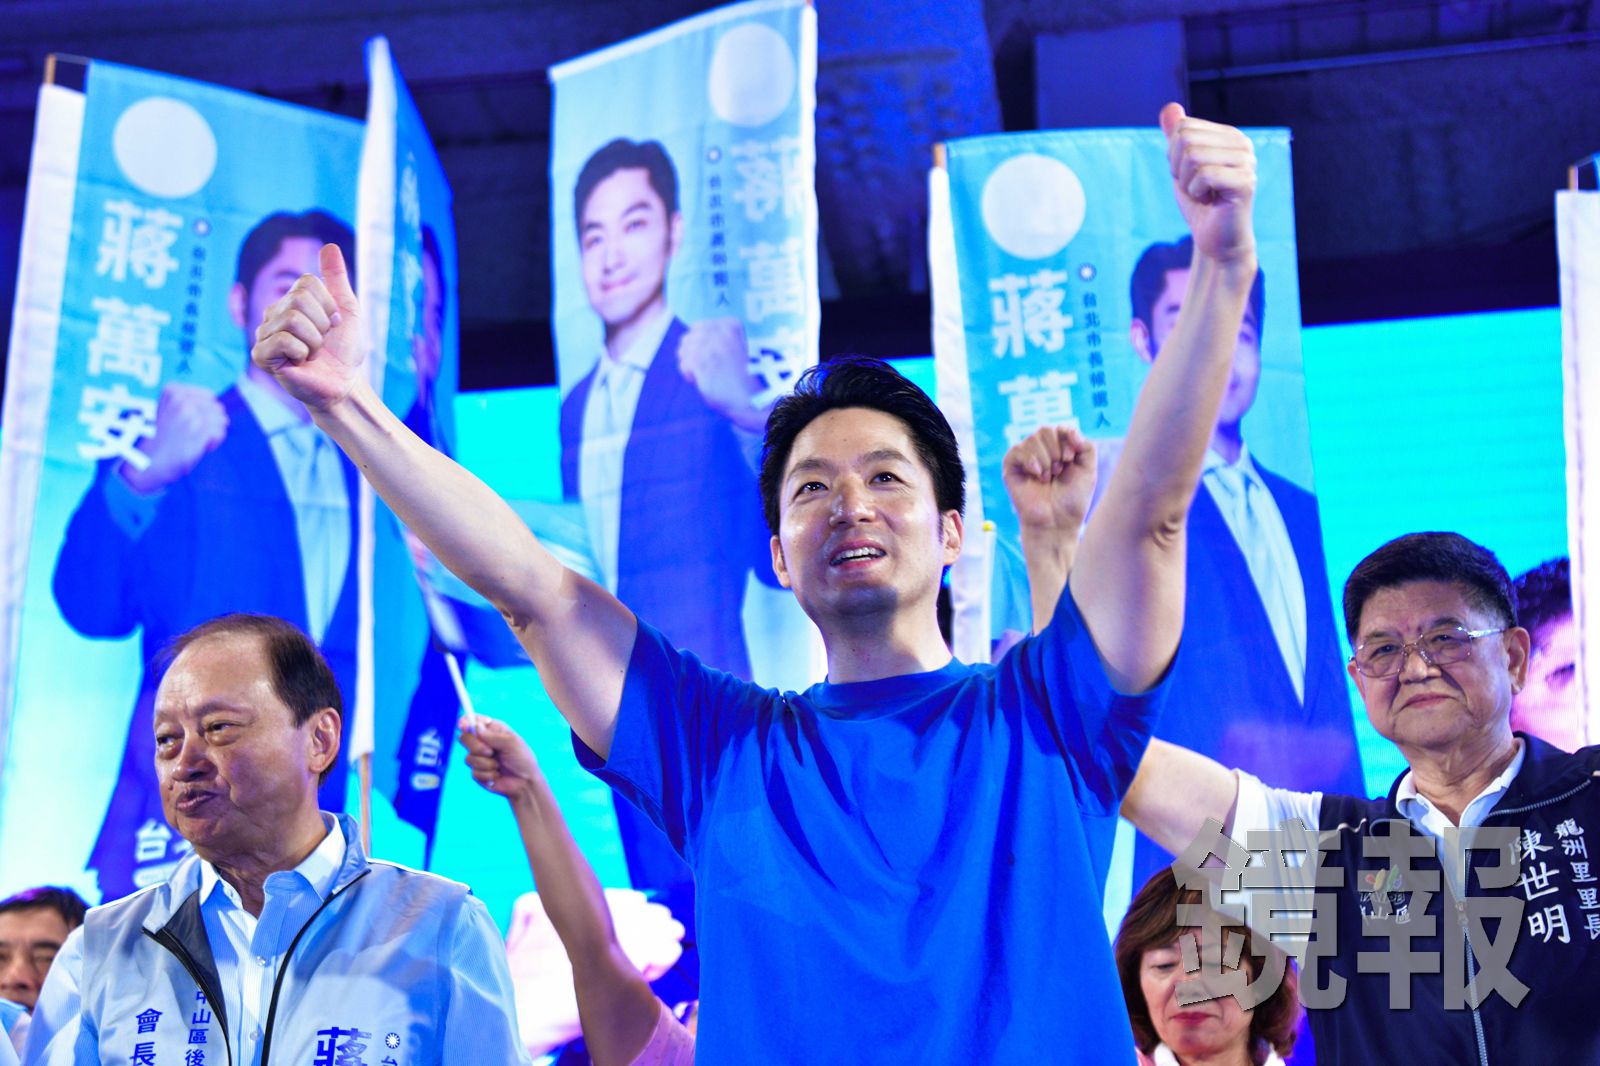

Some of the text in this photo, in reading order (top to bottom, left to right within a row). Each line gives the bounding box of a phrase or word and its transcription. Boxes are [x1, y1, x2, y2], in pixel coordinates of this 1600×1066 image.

[77, 199, 184, 472] 蔣萬安
[1508, 829, 1571, 943] 陳世明
[129, 1008, 163, 1066] 會長
